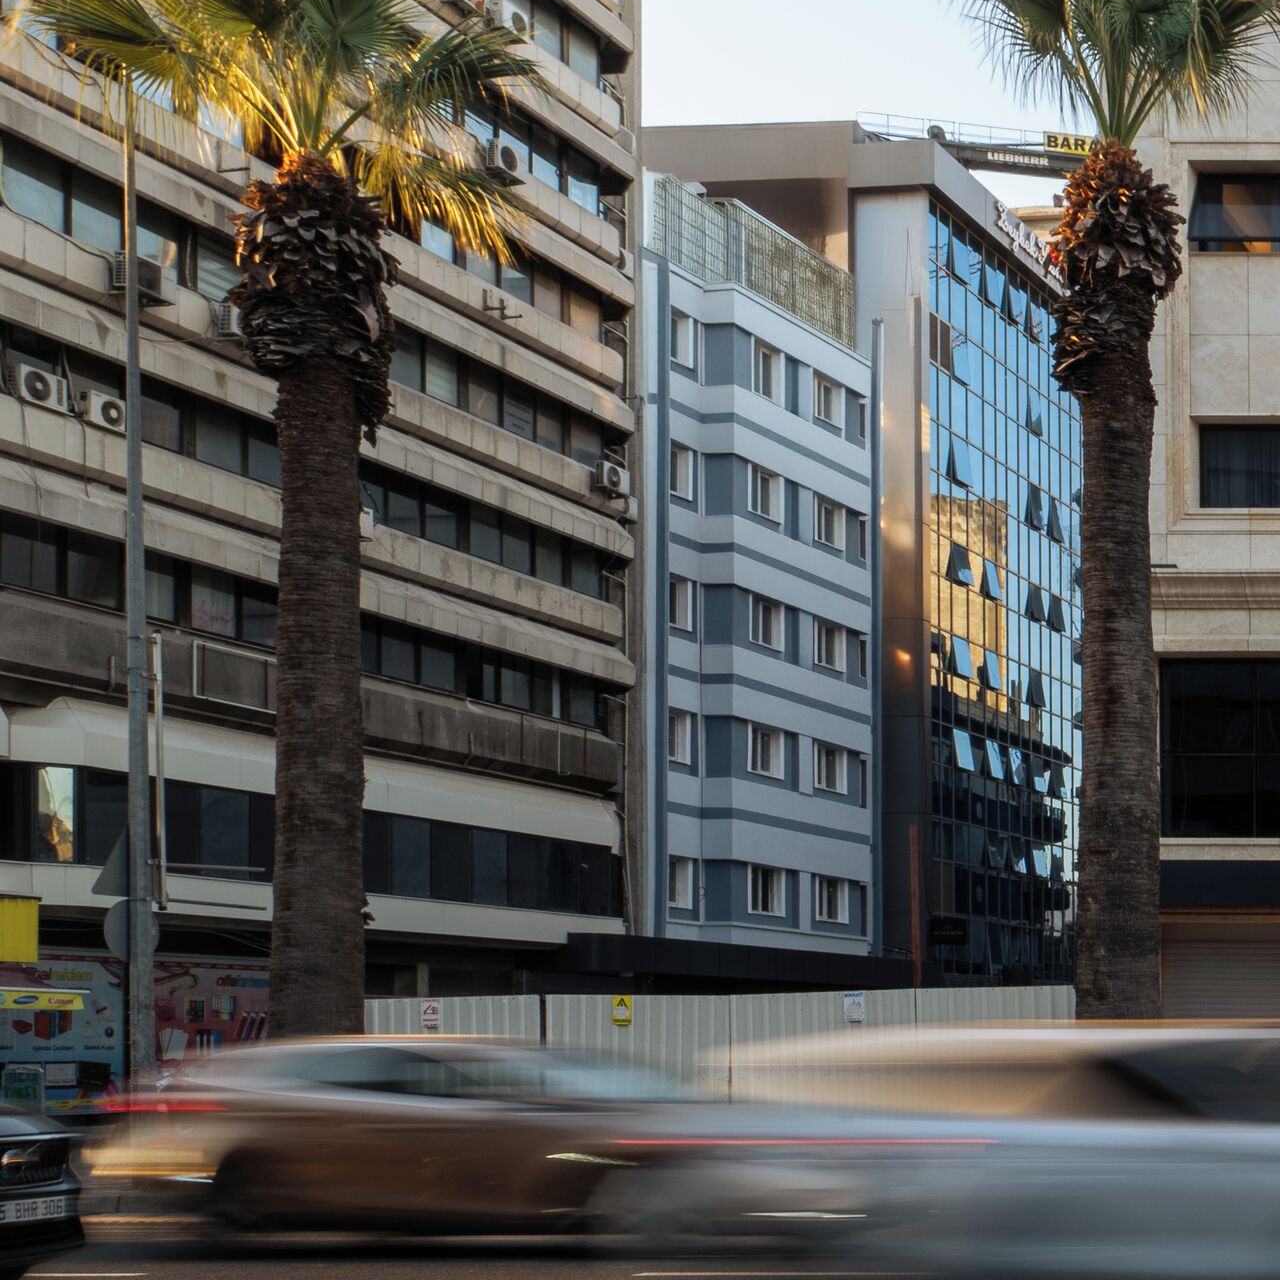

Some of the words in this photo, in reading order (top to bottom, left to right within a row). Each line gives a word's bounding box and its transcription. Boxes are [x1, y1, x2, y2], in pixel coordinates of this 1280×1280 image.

[987, 151, 1049, 166] LIEBHERR
[48, 997, 74, 1005] Canon
[15, 1201, 38, 1219] BHR
[41, 1199, 63, 1217] 306
